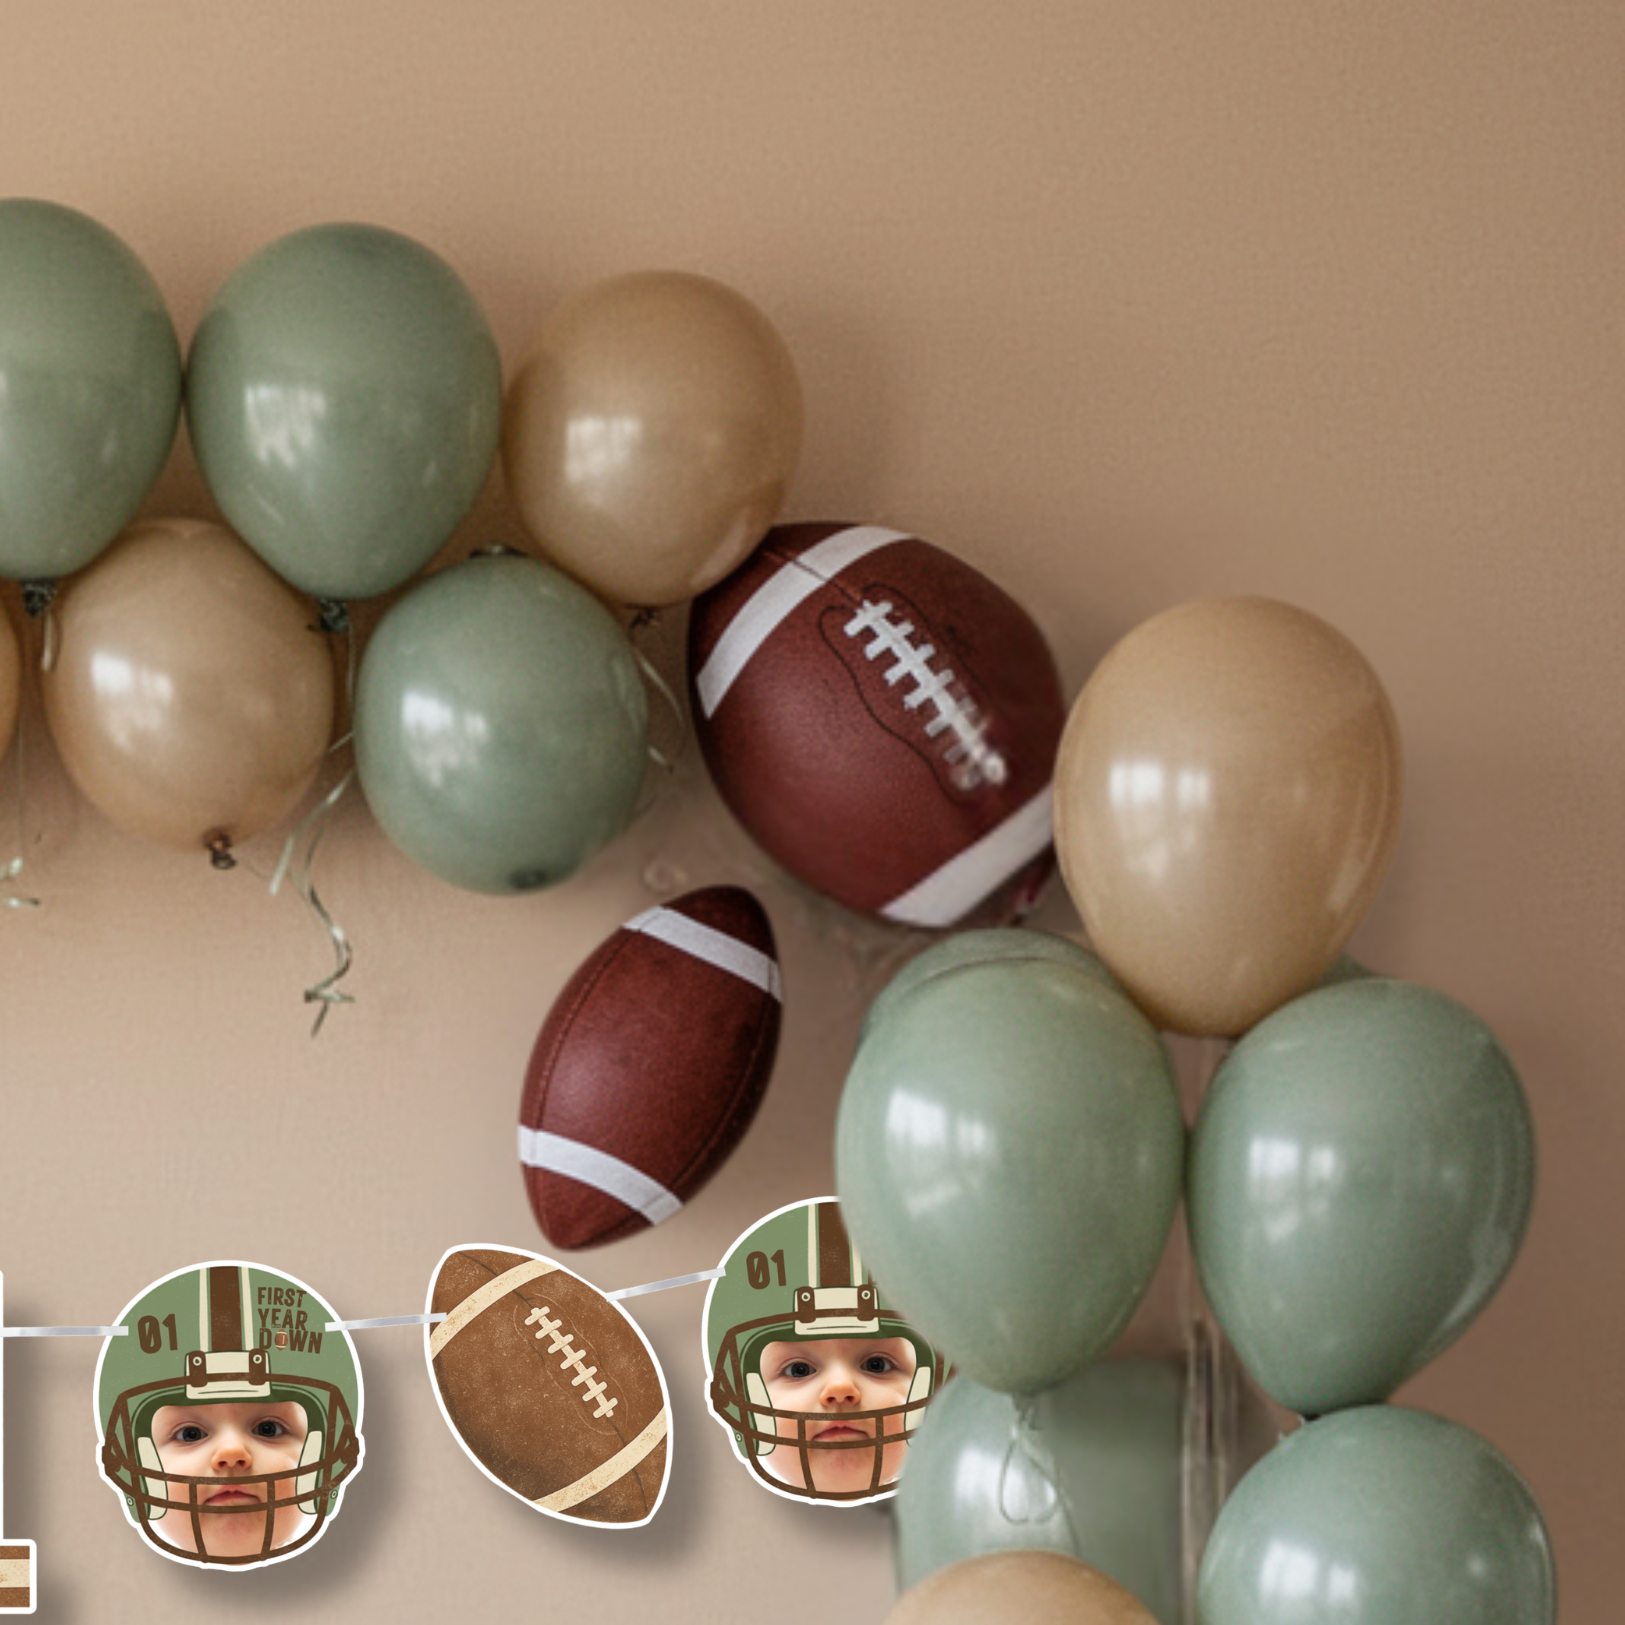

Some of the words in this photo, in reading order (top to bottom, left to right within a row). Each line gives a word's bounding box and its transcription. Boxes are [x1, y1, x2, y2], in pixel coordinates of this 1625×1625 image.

[746, 1249, 787, 1290] 01
[257, 1287, 306, 1308] FIRST
[257, 1308, 308, 1331] YEAR
[137, 1313, 178, 1354] 01
[259, 1328, 323, 1354] DOWN
